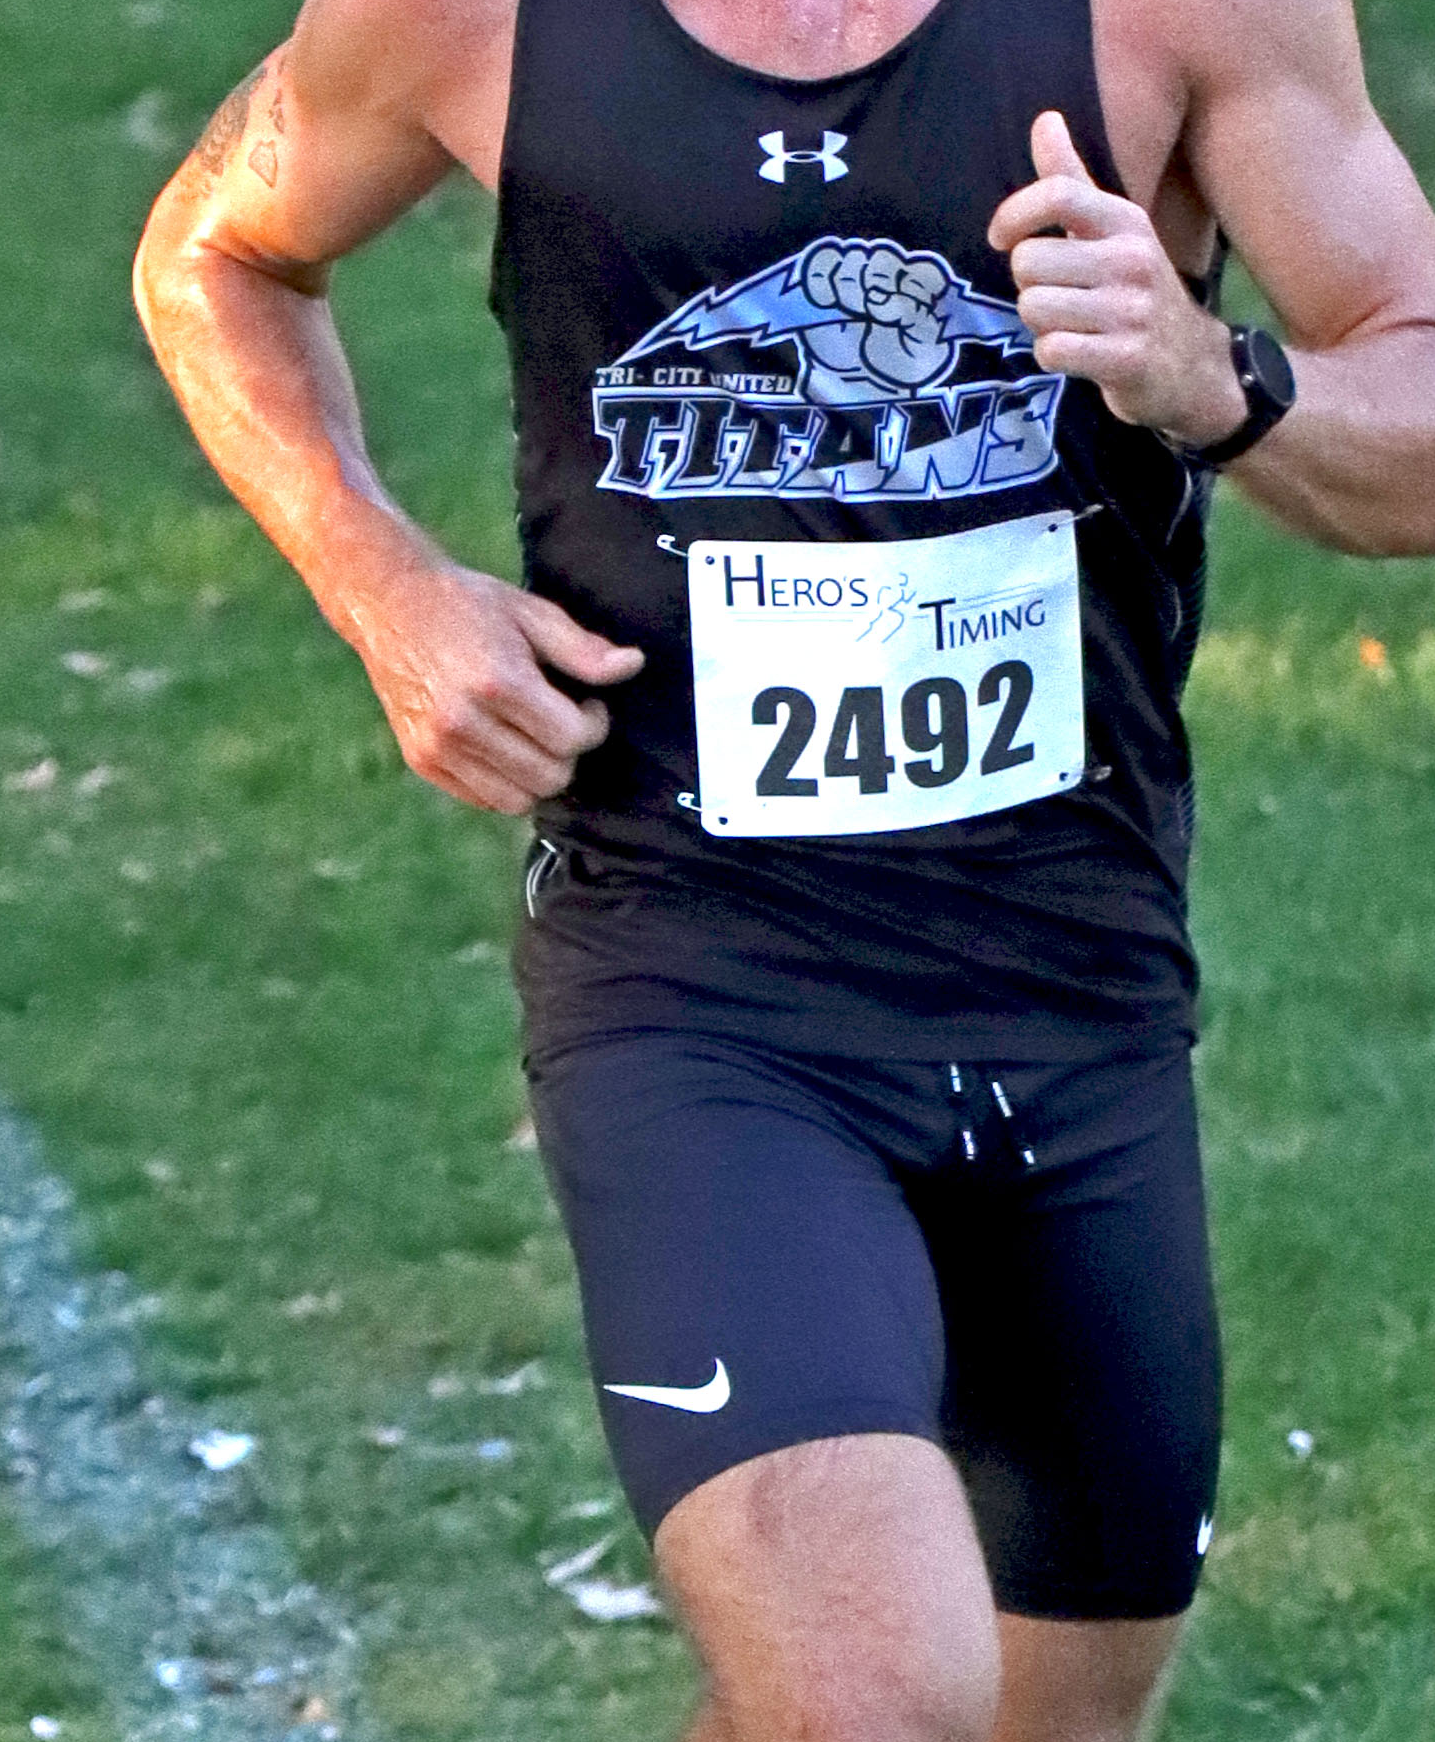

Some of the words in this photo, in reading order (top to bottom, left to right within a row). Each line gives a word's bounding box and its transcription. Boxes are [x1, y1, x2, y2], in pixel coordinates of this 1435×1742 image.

[652, 366, 705, 386] CITY
[593, 374, 1065, 501] TITANS
[917, 596, 1046, 652] TIMING
[751, 659, 1035, 798] 2492
